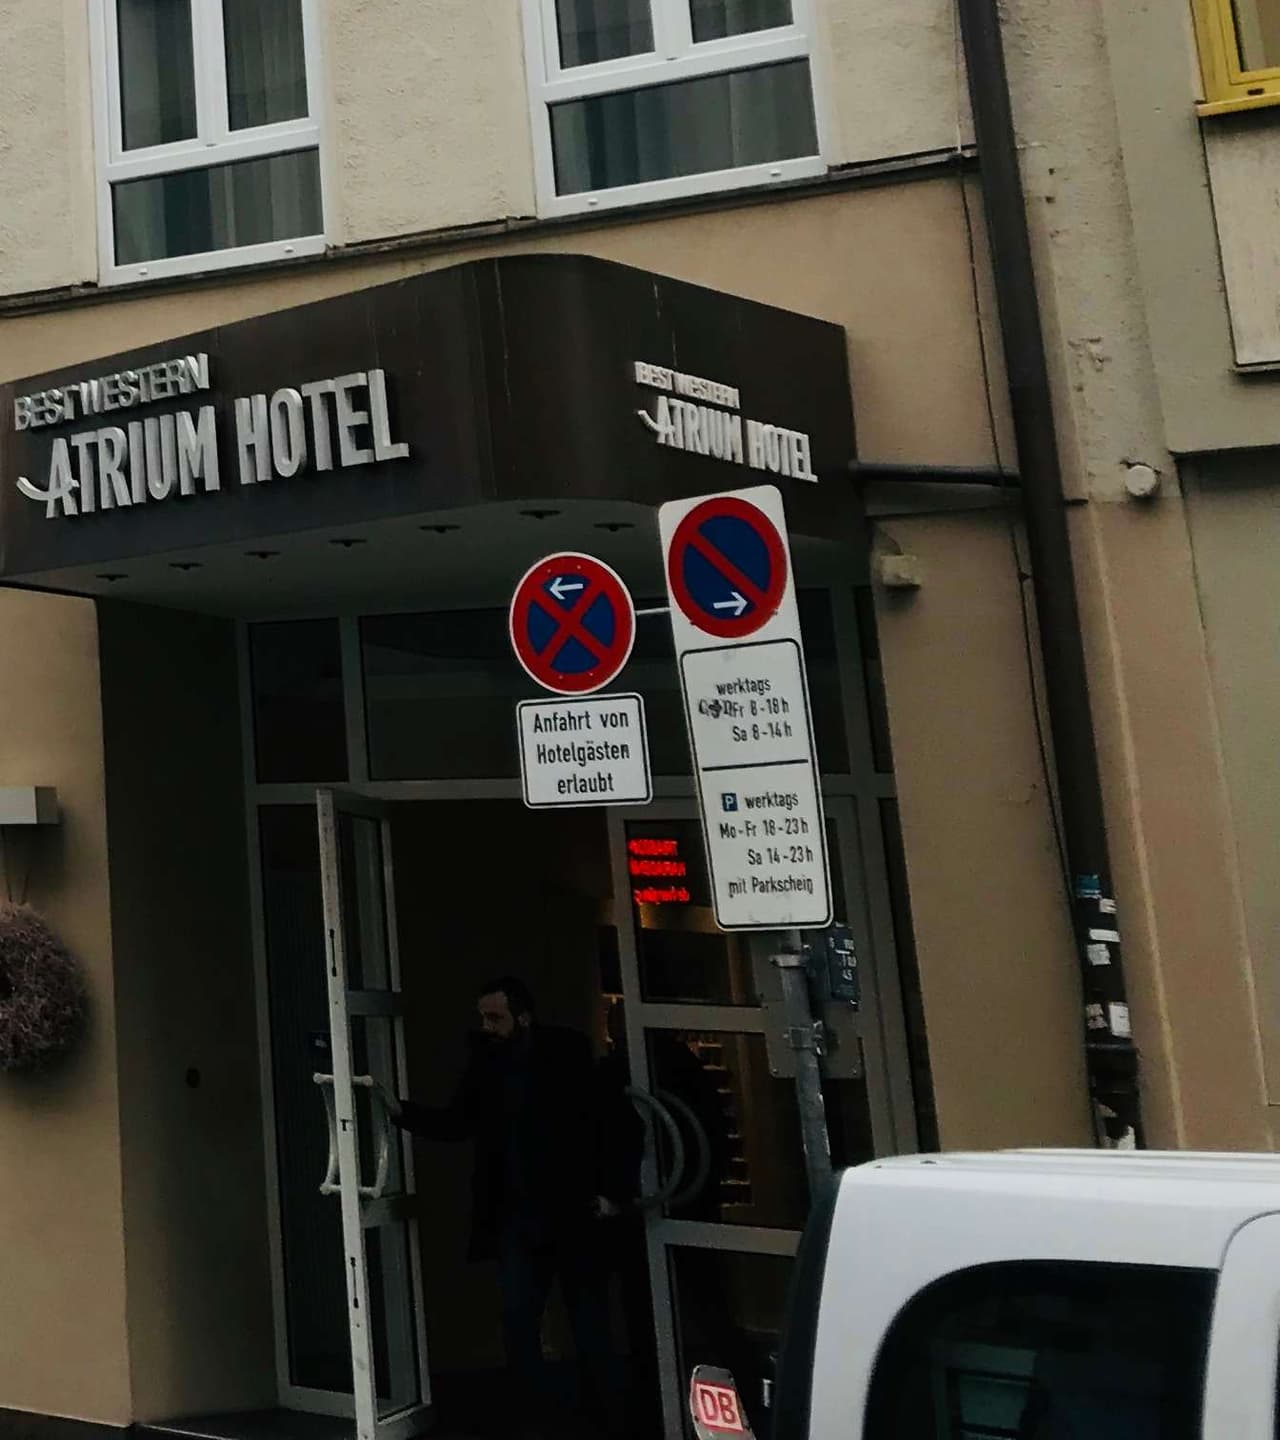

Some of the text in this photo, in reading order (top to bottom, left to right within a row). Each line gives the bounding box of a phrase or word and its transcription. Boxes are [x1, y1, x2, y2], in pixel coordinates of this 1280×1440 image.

[14, 353, 210, 431] BEST WESTERN
[634, 361, 740, 409] BEST WESTERN
[16, 369, 410, 519] ATRIUM HOTEL
[638, 395, 818, 482] ATRIUM HOTEL
[716, 677, 771, 696] werktags
[534, 710, 629, 733] Anfahrt von
[732, 725, 748, 742] Sa
[537, 740, 630, 767] Hotelgästen
[557, 771, 614, 794] erlaubt
[745, 791, 799, 810] werktags
[748, 848, 762, 865] Sa
[728, 874, 814, 897] mit Parkschein
[700, 1388, 737, 1424] DB
